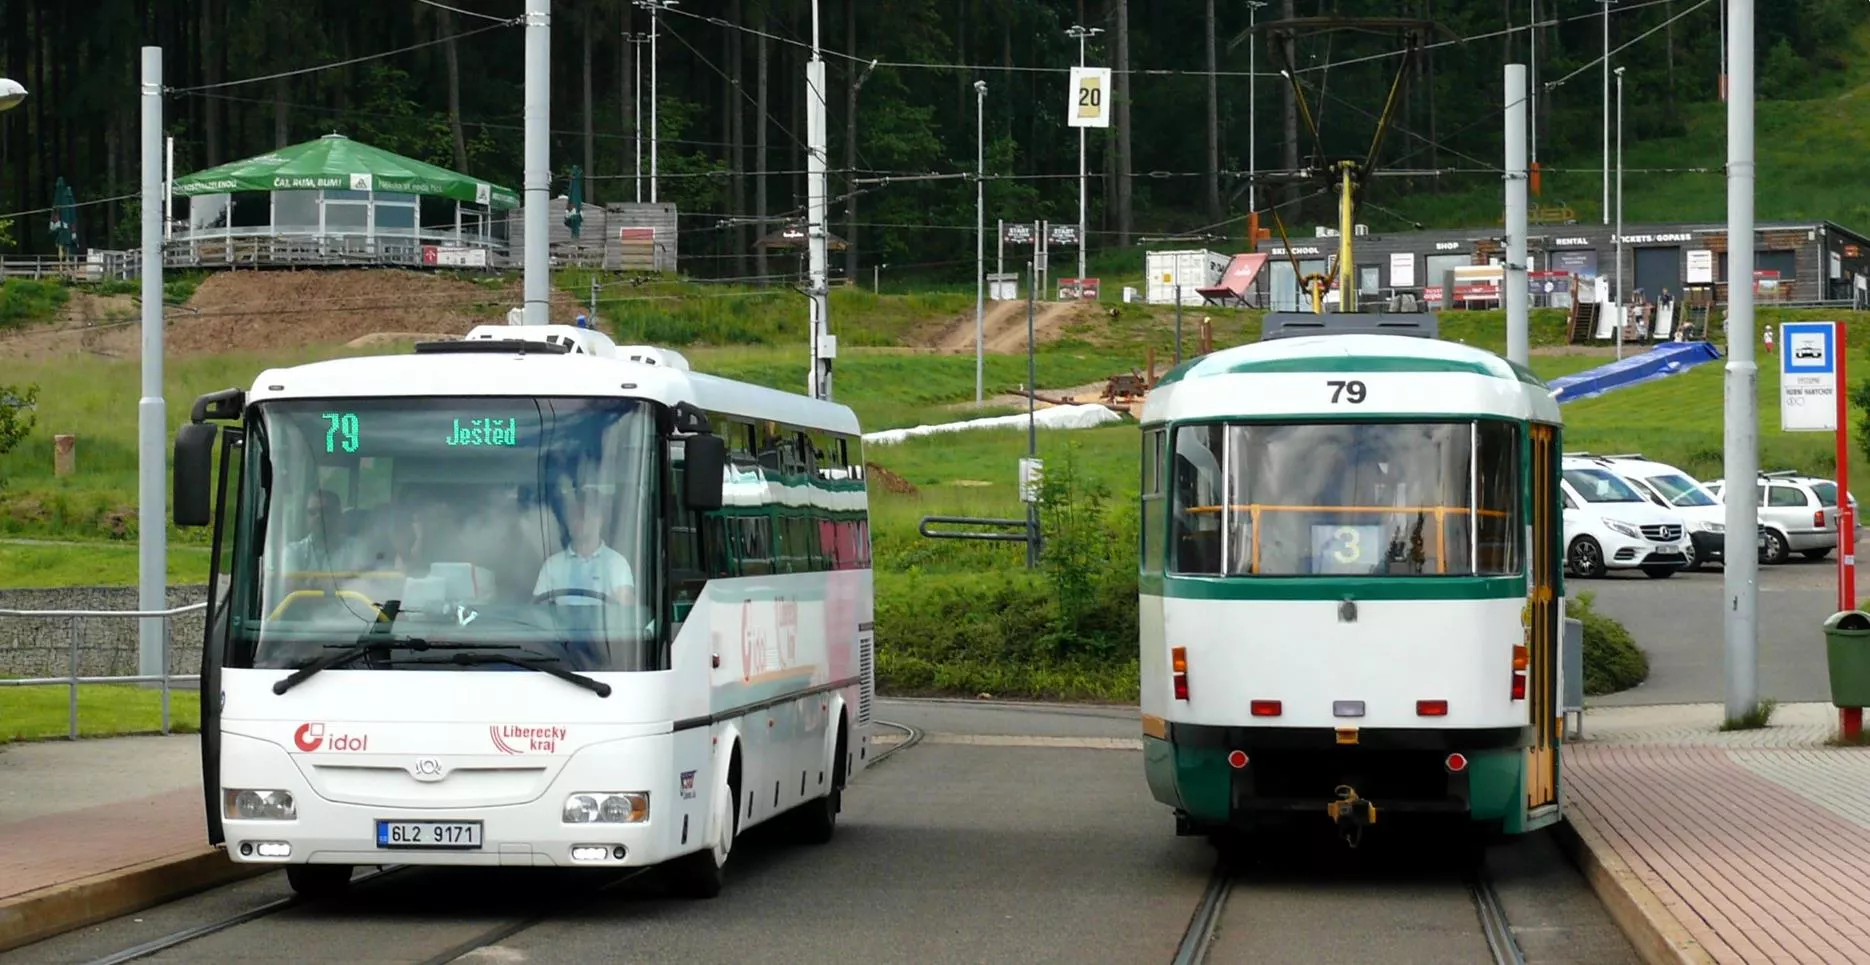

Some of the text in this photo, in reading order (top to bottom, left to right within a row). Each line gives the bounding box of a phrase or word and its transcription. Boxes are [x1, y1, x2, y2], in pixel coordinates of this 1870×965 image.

[1079, 87, 1101, 107] 20
[1435, 242, 1459, 250] SHOP
[1556, 237, 1588, 246] RENTAL
[1326, 380, 1367, 404] 79
[321, 412, 516, 453] 79 Ještěd
[1333, 525, 1361, 564] 3
[502, 724, 567, 741] Liberecký
[328, 734, 368, 751] idol
[530, 739, 556, 754] kraj
[391, 825, 473, 844] 6L2 9171
